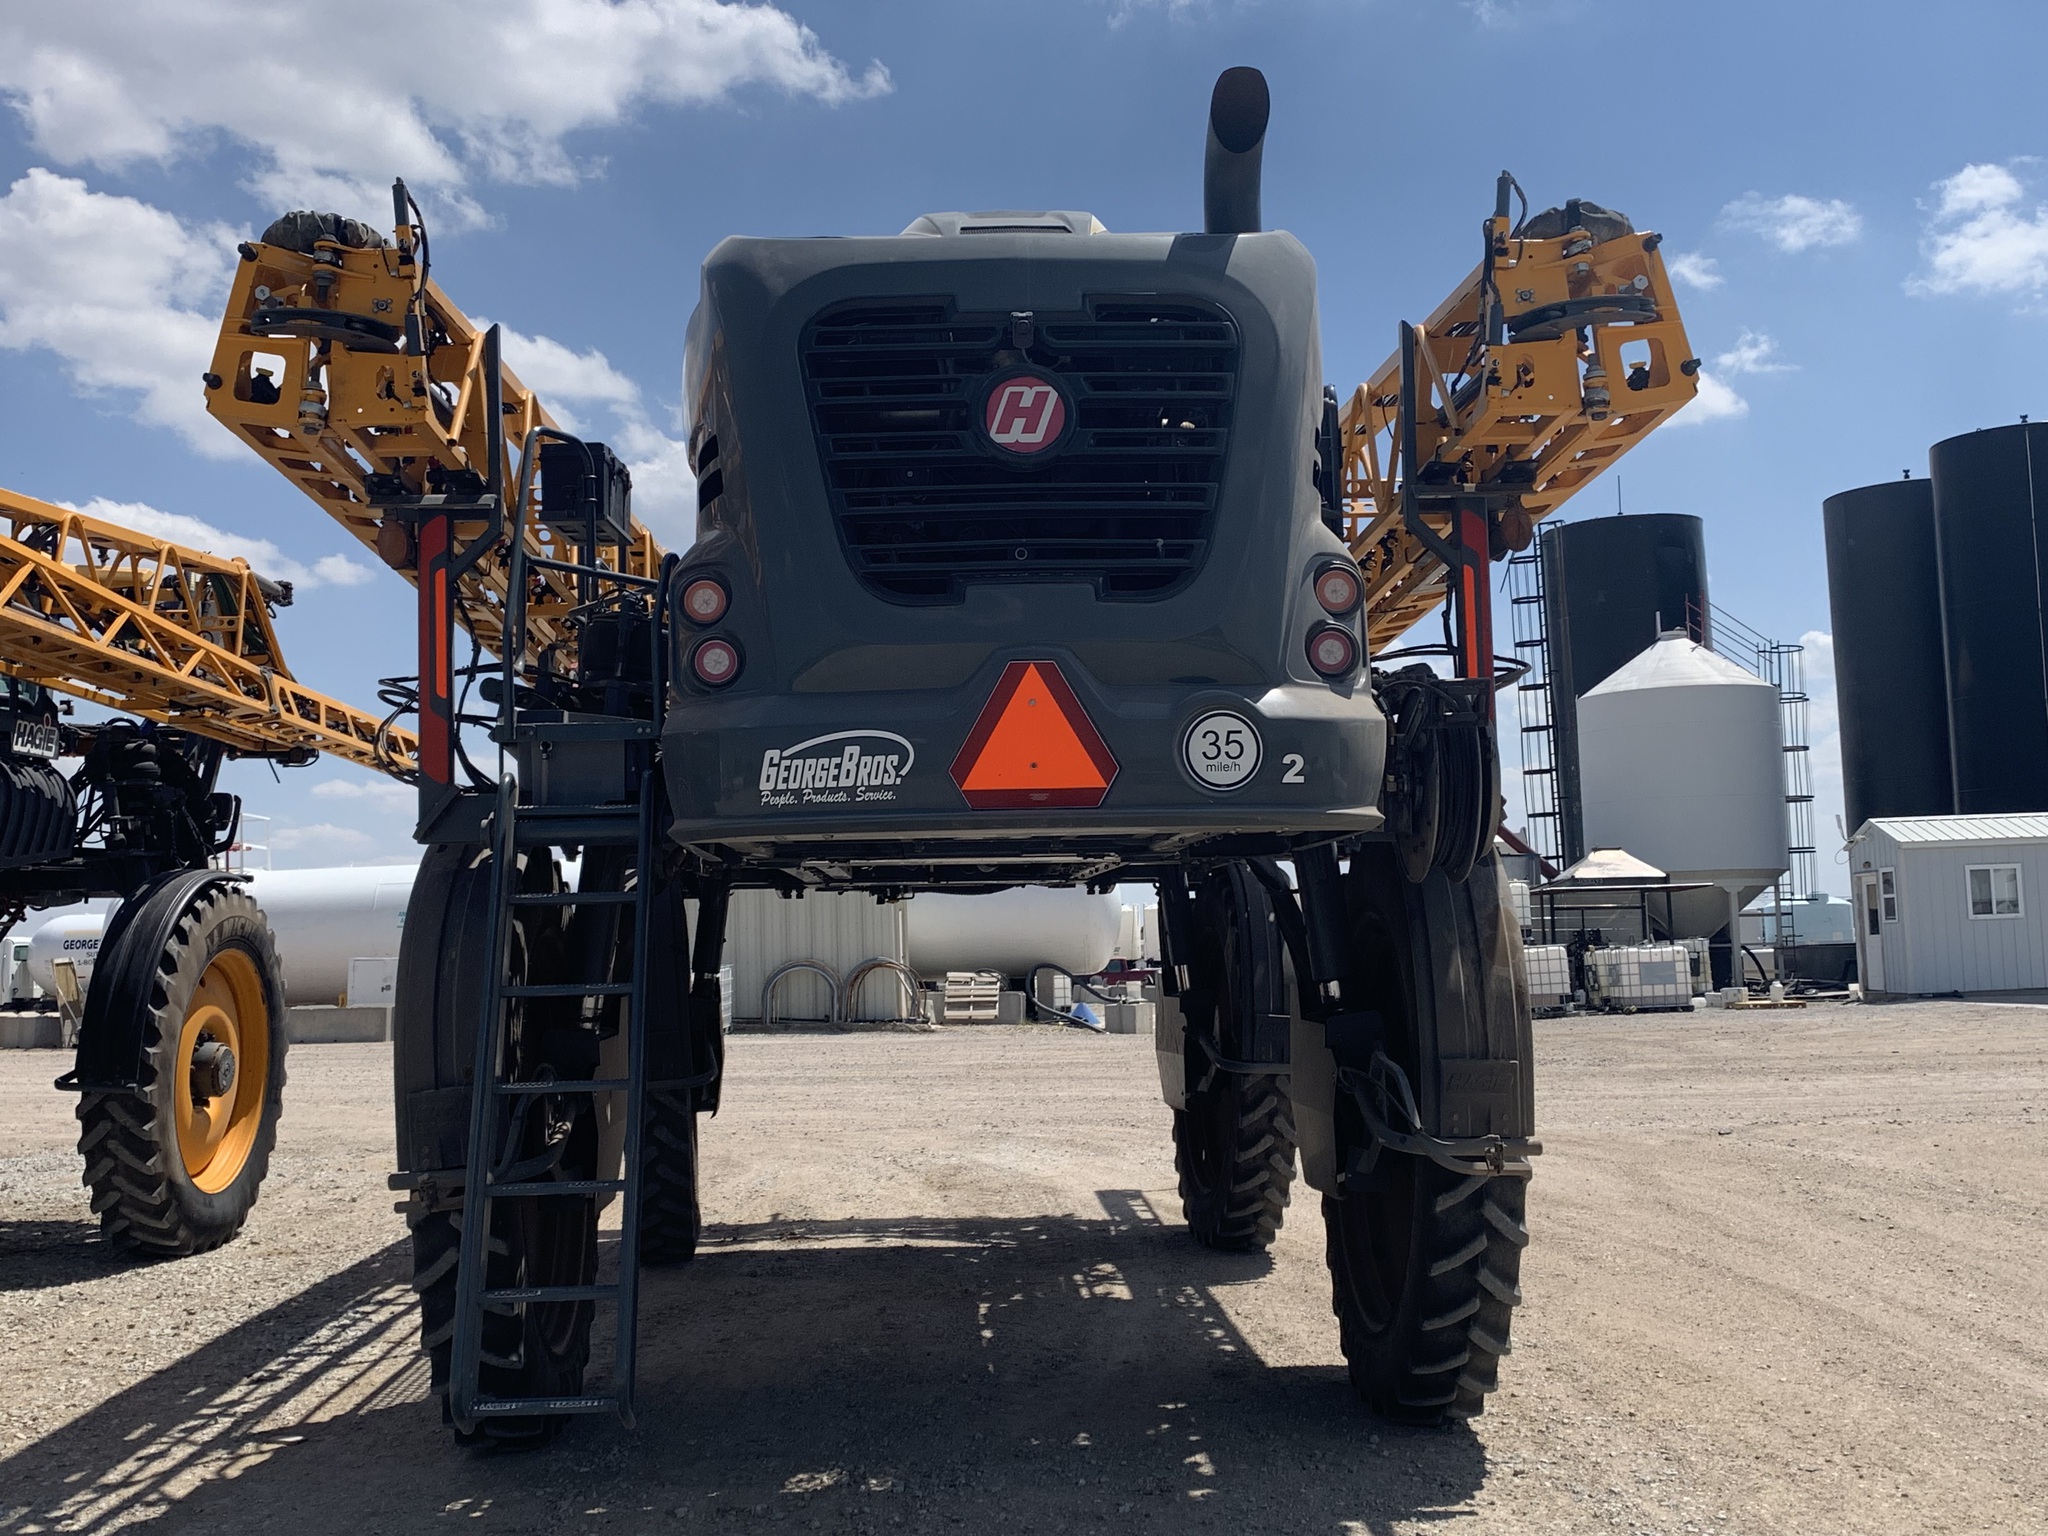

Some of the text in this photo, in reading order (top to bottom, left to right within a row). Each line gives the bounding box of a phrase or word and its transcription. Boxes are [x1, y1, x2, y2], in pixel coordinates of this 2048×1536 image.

[990, 386, 1058, 443] H
[13, 714, 58, 757] HAGIE
[1202, 730, 1244, 760] 35
[1206, 761, 1241, 772] mile/h
[1282, 753, 1305, 783] 2
[760, 786, 896, 808] People. Products. Service.
